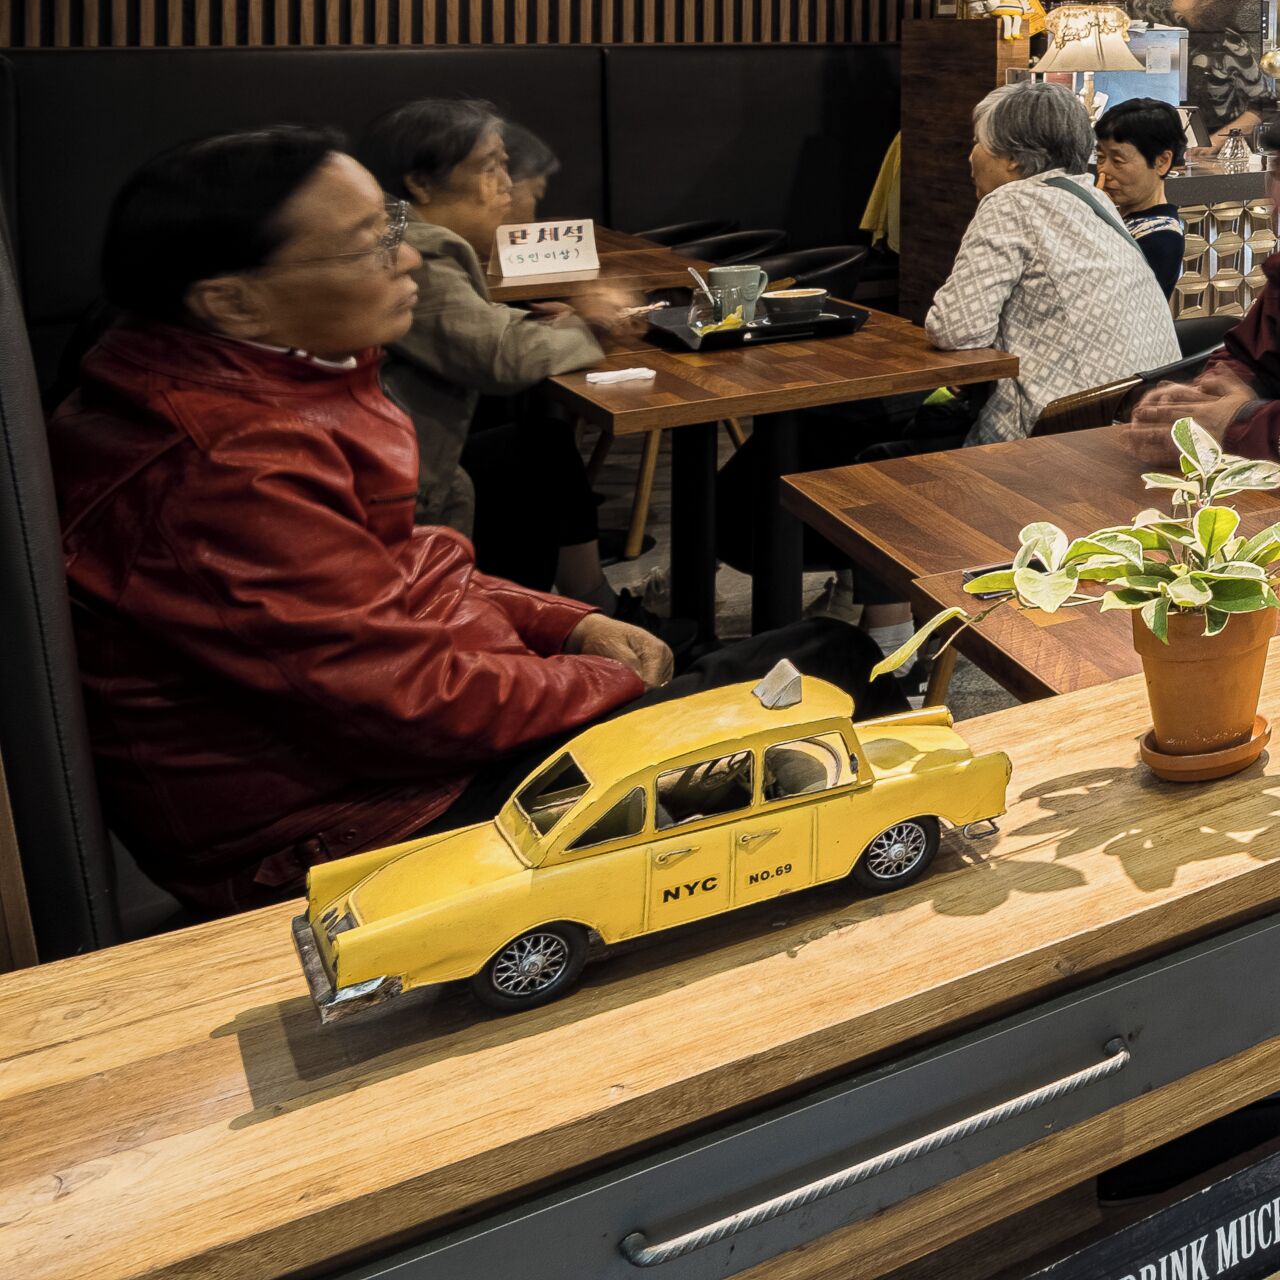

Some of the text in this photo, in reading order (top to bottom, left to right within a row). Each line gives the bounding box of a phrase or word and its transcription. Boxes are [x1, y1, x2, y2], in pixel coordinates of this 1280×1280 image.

[508, 225, 584, 245] 단체석
[749, 863, 793, 885] NO.69
[663, 876, 718, 903] NYC
[1119, 1233, 1210, 1280] INK
